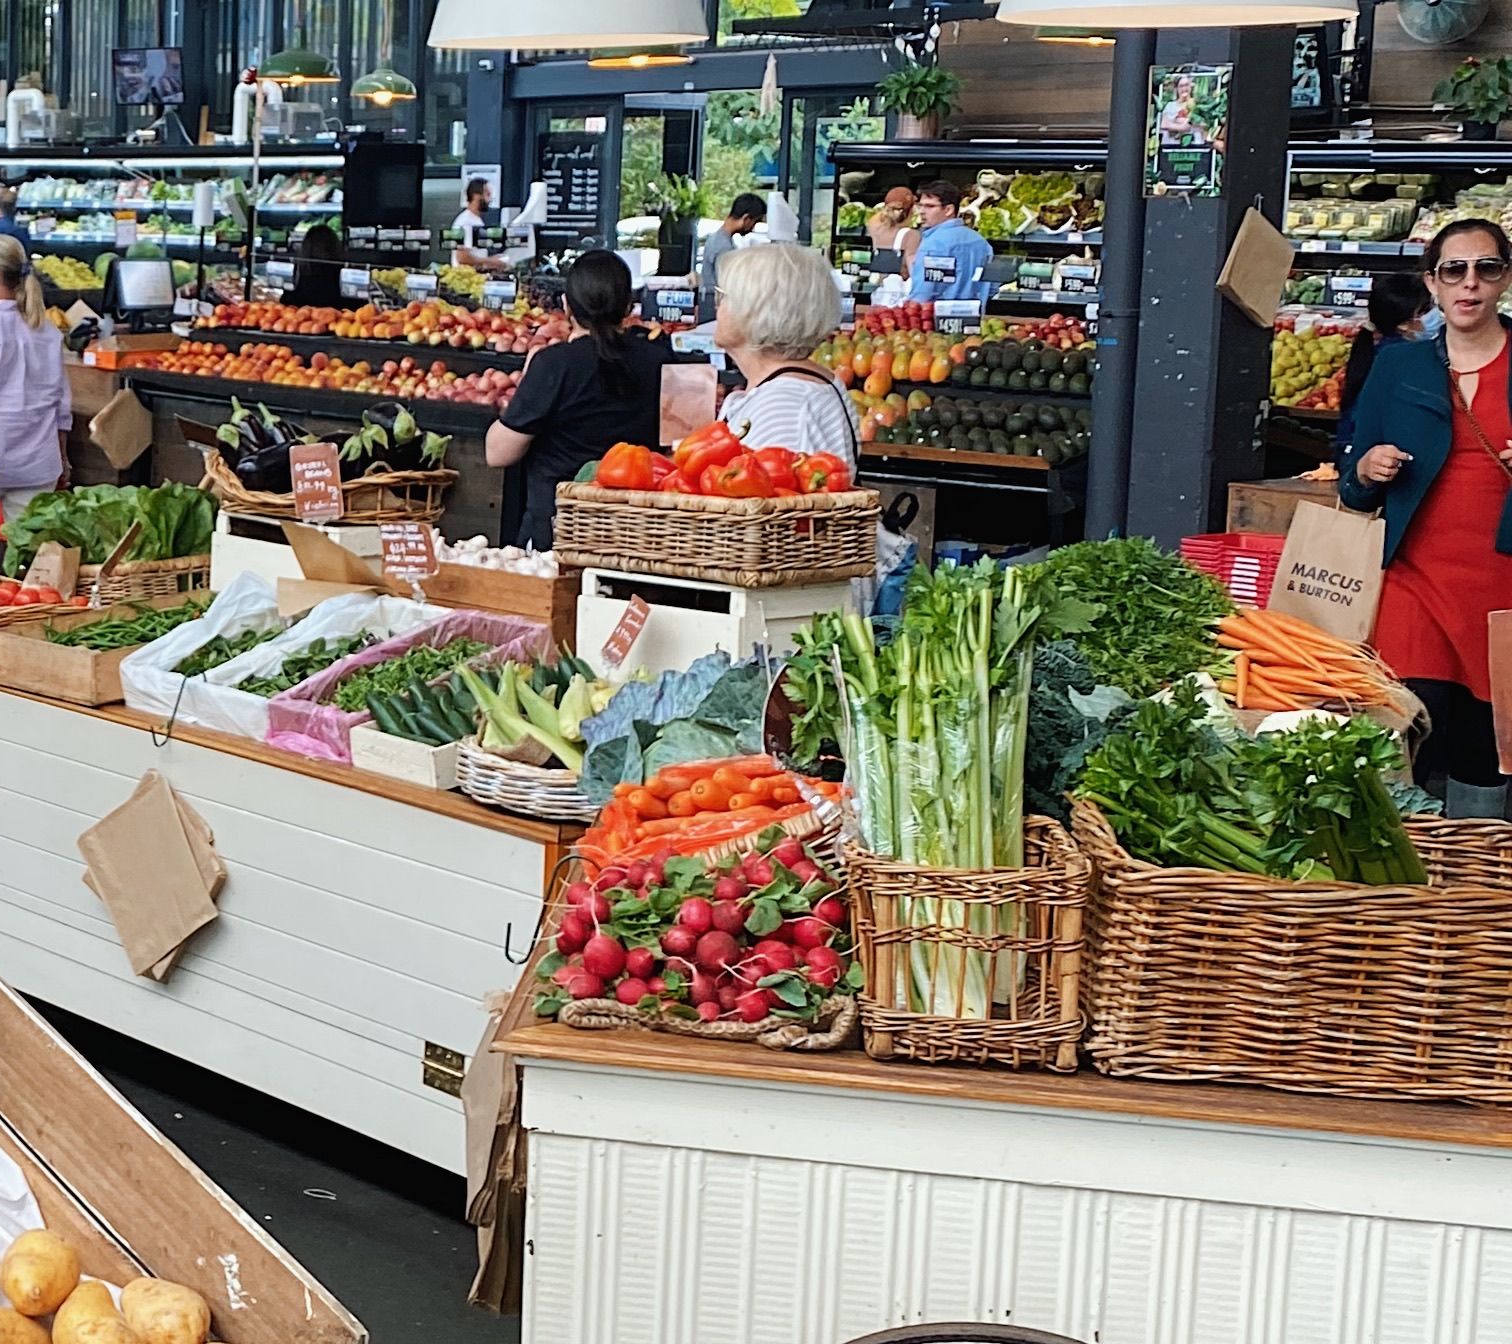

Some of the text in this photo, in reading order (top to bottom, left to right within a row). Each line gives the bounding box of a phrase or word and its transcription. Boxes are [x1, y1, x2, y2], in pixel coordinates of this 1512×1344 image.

[1291, 562, 1363, 593] MARCUS
[1287, 580, 1353, 607] & BURTON
